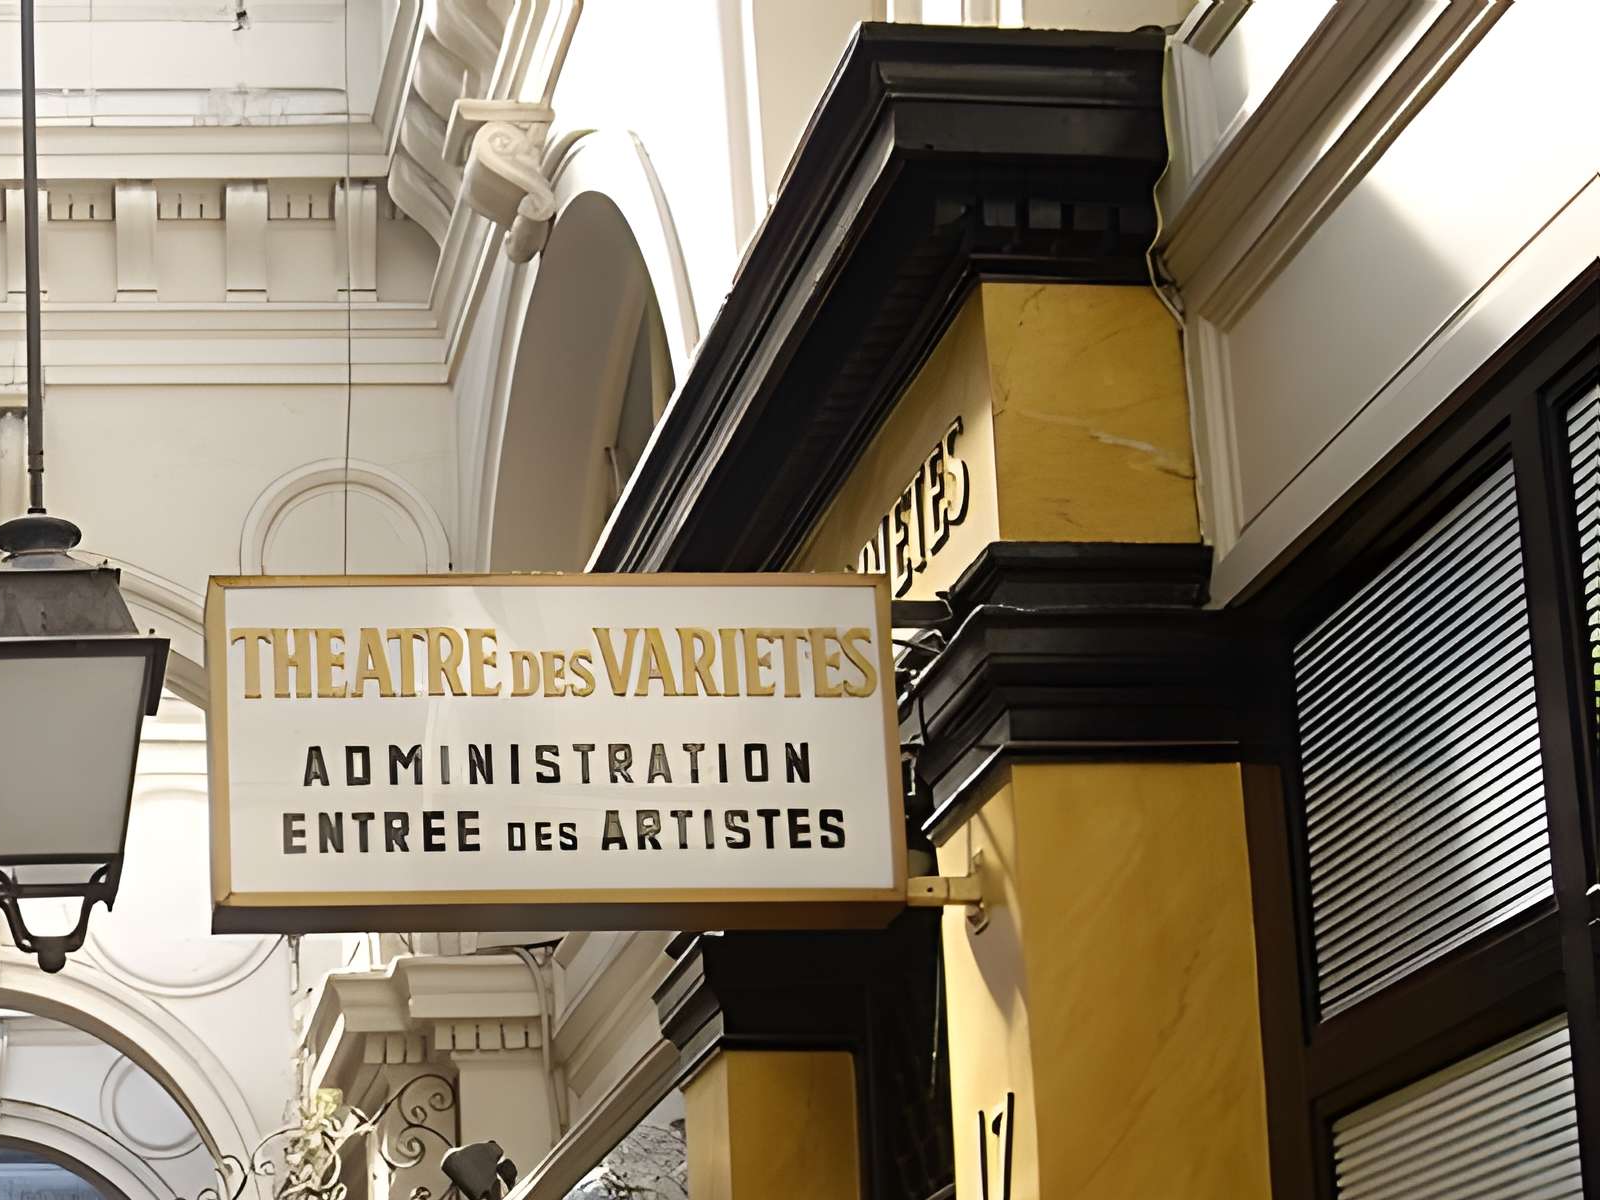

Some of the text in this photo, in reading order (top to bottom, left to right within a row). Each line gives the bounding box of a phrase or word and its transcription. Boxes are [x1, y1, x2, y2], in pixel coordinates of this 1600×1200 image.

[230, 626, 879, 698] THEATRE DES VARIETES
[303, 741, 811, 787] ADMINISTRATION
[282, 808, 846, 855] ENTREE DES ARTISTES
